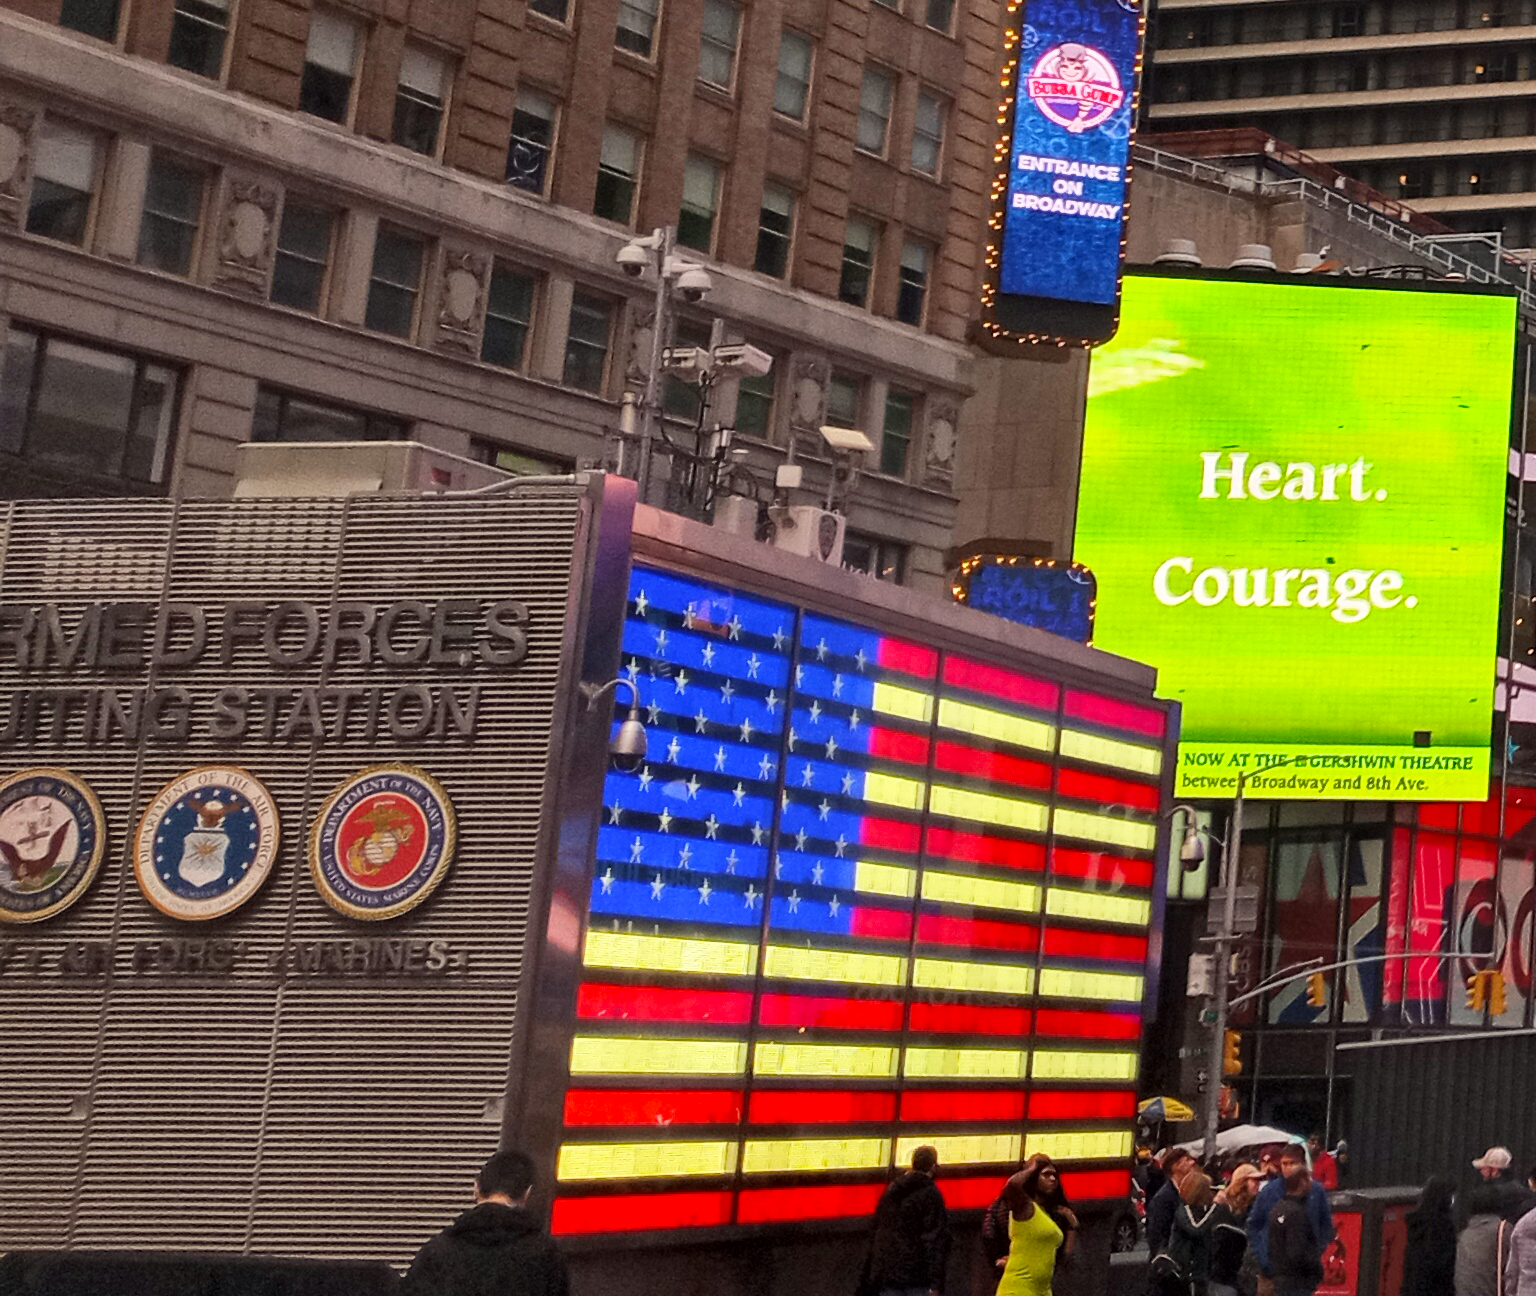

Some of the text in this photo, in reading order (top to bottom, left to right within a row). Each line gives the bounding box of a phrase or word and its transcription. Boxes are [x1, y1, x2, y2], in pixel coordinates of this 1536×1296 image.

[1032, 81, 1078, 96] BUBBA
[1081, 84, 1120, 105] GUMP
[1018, 155, 1121, 182] ENTRANCE
[1053, 179, 1084, 196] ON
[1012, 193, 1121, 220] BROADWAY
[1199, 452, 1388, 503] Heart.
[1153, 555, 1419, 624] Courage.
[219, 599, 530, 667] FORCES
[207, 685, 481, 741] STATION
[1184, 753, 1474, 770] NOW AT THE GERSHWIN THEATRE
[1251, 775, 1330, 793] Broadway
[1333, 775, 1361, 790] and
[1366, 775, 1392, 791] 8th
[1396, 776, 1430, 791] Ave.
[138, 779, 191, 865] DEPARTMENT
[197, 773, 217, 785] OF
[250, 793, 270, 818] AIR
[322, 777, 389, 843] DEPARTMENT
[421, 796, 442, 830] NAVY
